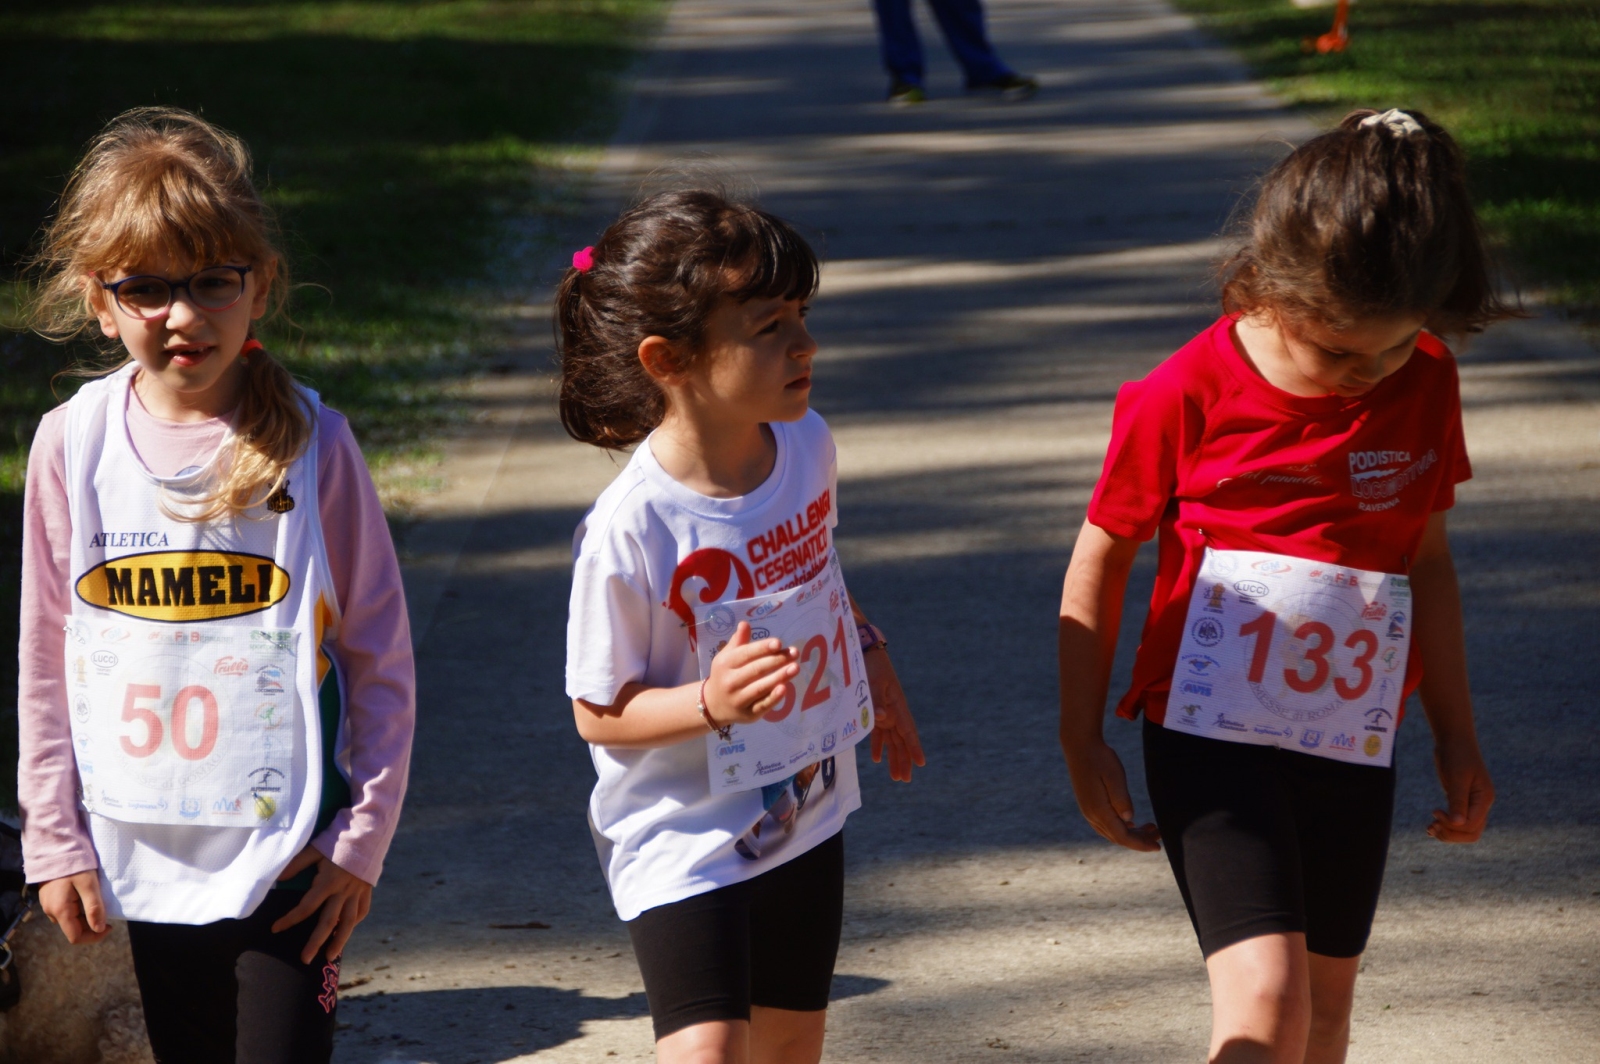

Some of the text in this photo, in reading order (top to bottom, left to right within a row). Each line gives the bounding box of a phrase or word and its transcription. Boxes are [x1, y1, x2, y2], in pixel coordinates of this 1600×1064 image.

[1348, 450, 1411, 473] PODISTICA
[1358, 497, 1401, 512] RAVENNA
[89, 531, 170, 548] ATLETICA
[753, 524, 828, 592] CESENATICO
[104, 564, 272, 607] MAMELI
[1235, 582, 1267, 595] LUCCI
[755, 600, 774, 616] GM
[751, 630, 768, 640] CCI
[92, 654, 117, 664] LUCCI
[1239, 610, 1379, 701] 133
[119, 682, 219, 761] 50
[719, 743, 746, 756] AVIS
